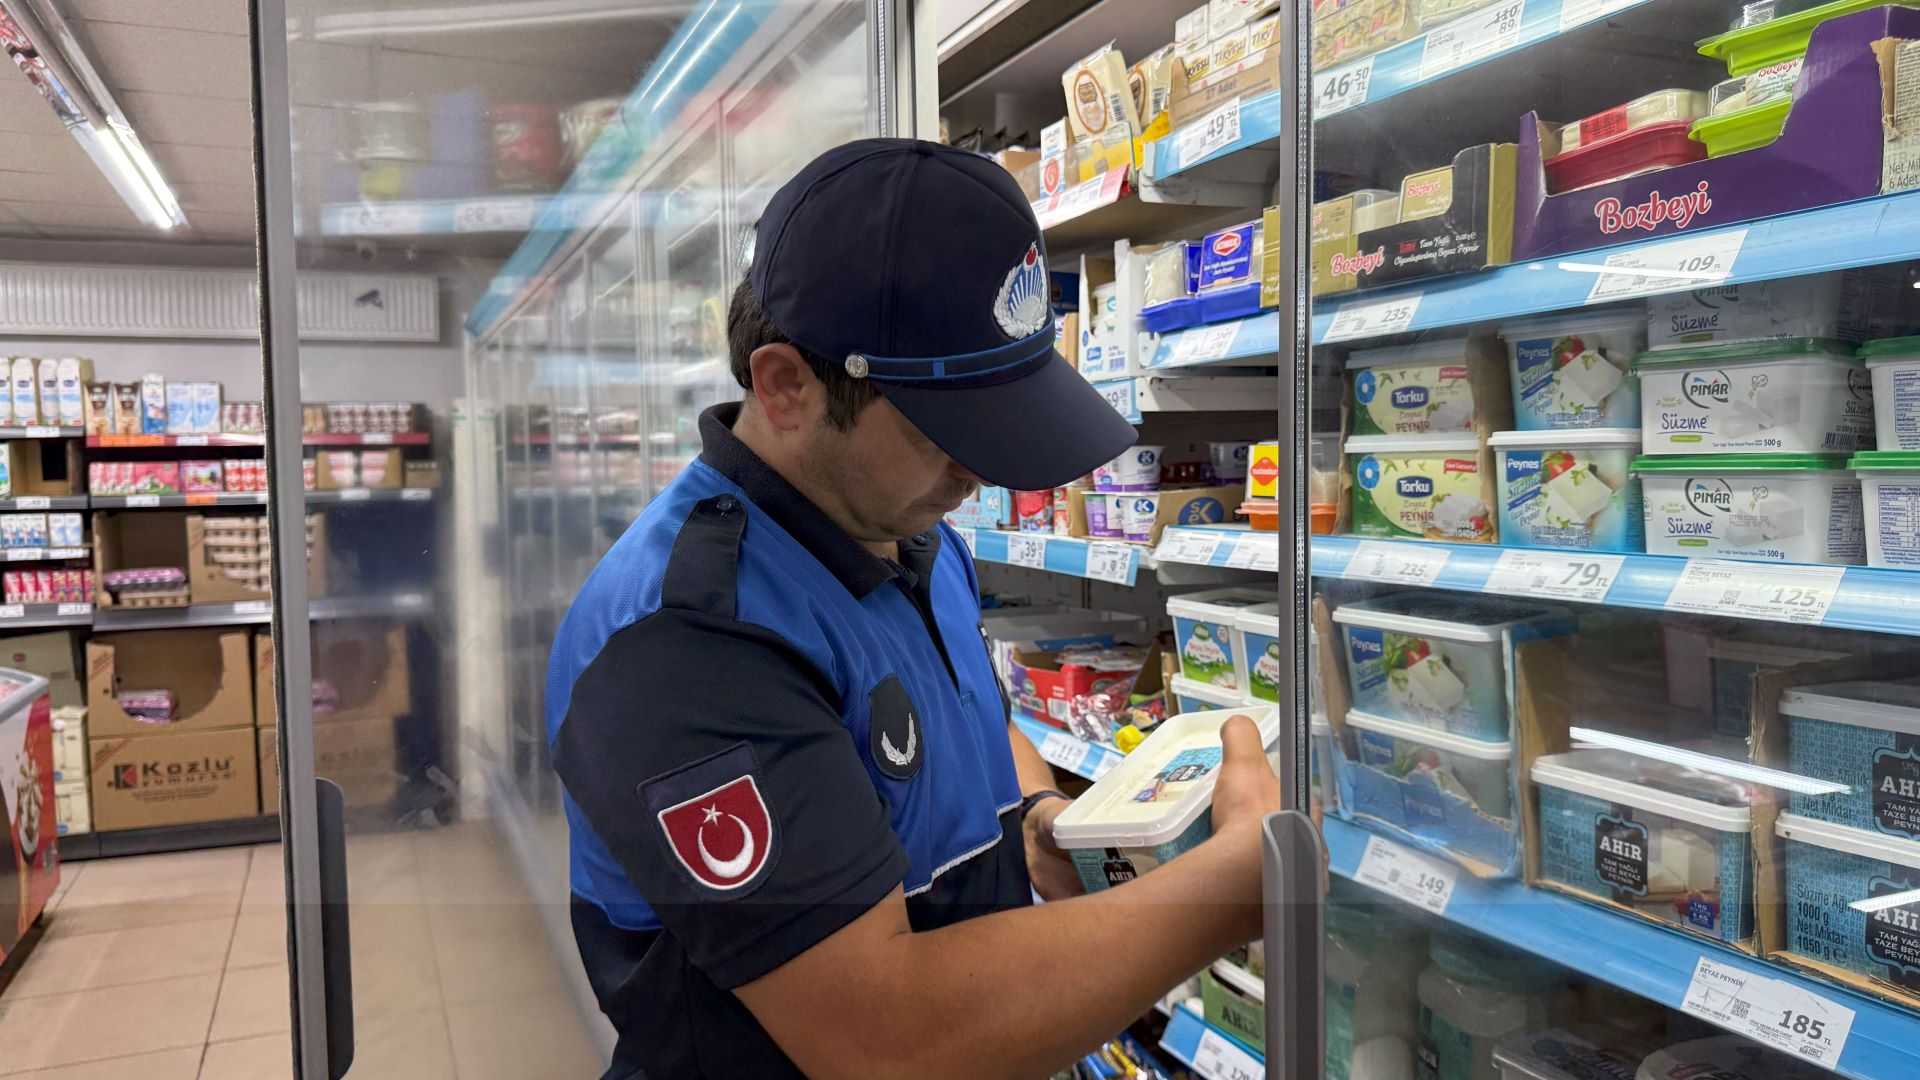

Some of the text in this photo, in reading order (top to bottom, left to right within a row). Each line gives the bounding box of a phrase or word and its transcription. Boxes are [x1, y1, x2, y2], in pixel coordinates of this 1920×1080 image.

[1889, 161, 1904, 174] Net
[1889, 174, 1919, 189] 6 Adet
[1594, 180, 1712, 234] Bozbeyi
[1457, 242, 1480, 255] Peynir
[1330, 245, 1385, 276] Bozbeyi
[1678, 255, 1715, 272] 109
[1381, 307, 1410, 323] 235
[1671, 311, 1720, 333] Süzme
[1518, 348, 1550, 361] Peynes
[1393, 390, 1425, 404] Torku
[1395, 419, 1431, 433] PEYNİR
[1661, 412, 1708, 430] Süzme
[1763, 438, 1776, 446] 500
[1507, 458, 1540, 471] Peynes
[1399, 479, 1430, 493] Torku
[1399, 508, 1435, 521] PEYNİR
[1668, 516, 1713, 534] Süzme
[1767, 550, 1779, 558] 500
[1560, 562, 1608, 587] 79 TL
[1769, 588, 1817, 607] 125
[1351, 636, 1381, 653] Peynes
[142, 757, 231, 776] Kozlu
[1803, 795, 1818, 812] Net
[1886, 802, 1920, 814] TAM YA
[1883, 809, 1920, 823] TAZE BE
[1893, 820, 1920, 831] PEYN
[1604, 857, 1617, 868] TAM
[1601, 863, 1641, 881] TAZE BEYAZ
[1415, 872, 1445, 894] 149
[1797, 883, 1829, 906] Süzme
[1797, 901, 1829, 927] 1000 g
[1874, 908, 1920, 932] AHİ
[1797, 918, 1813, 936] Net
[1797, 935, 1829, 961] 1050 g
[1874, 937, 1920, 957] TAZE BEY
[1879, 930, 1920, 949] TAM YAĞ
[1700, 966, 1743, 986] BEYAZ PEYNİR
[1778, 1009, 1825, 1040] 185
[1824, 1037, 1832, 1046] TL
